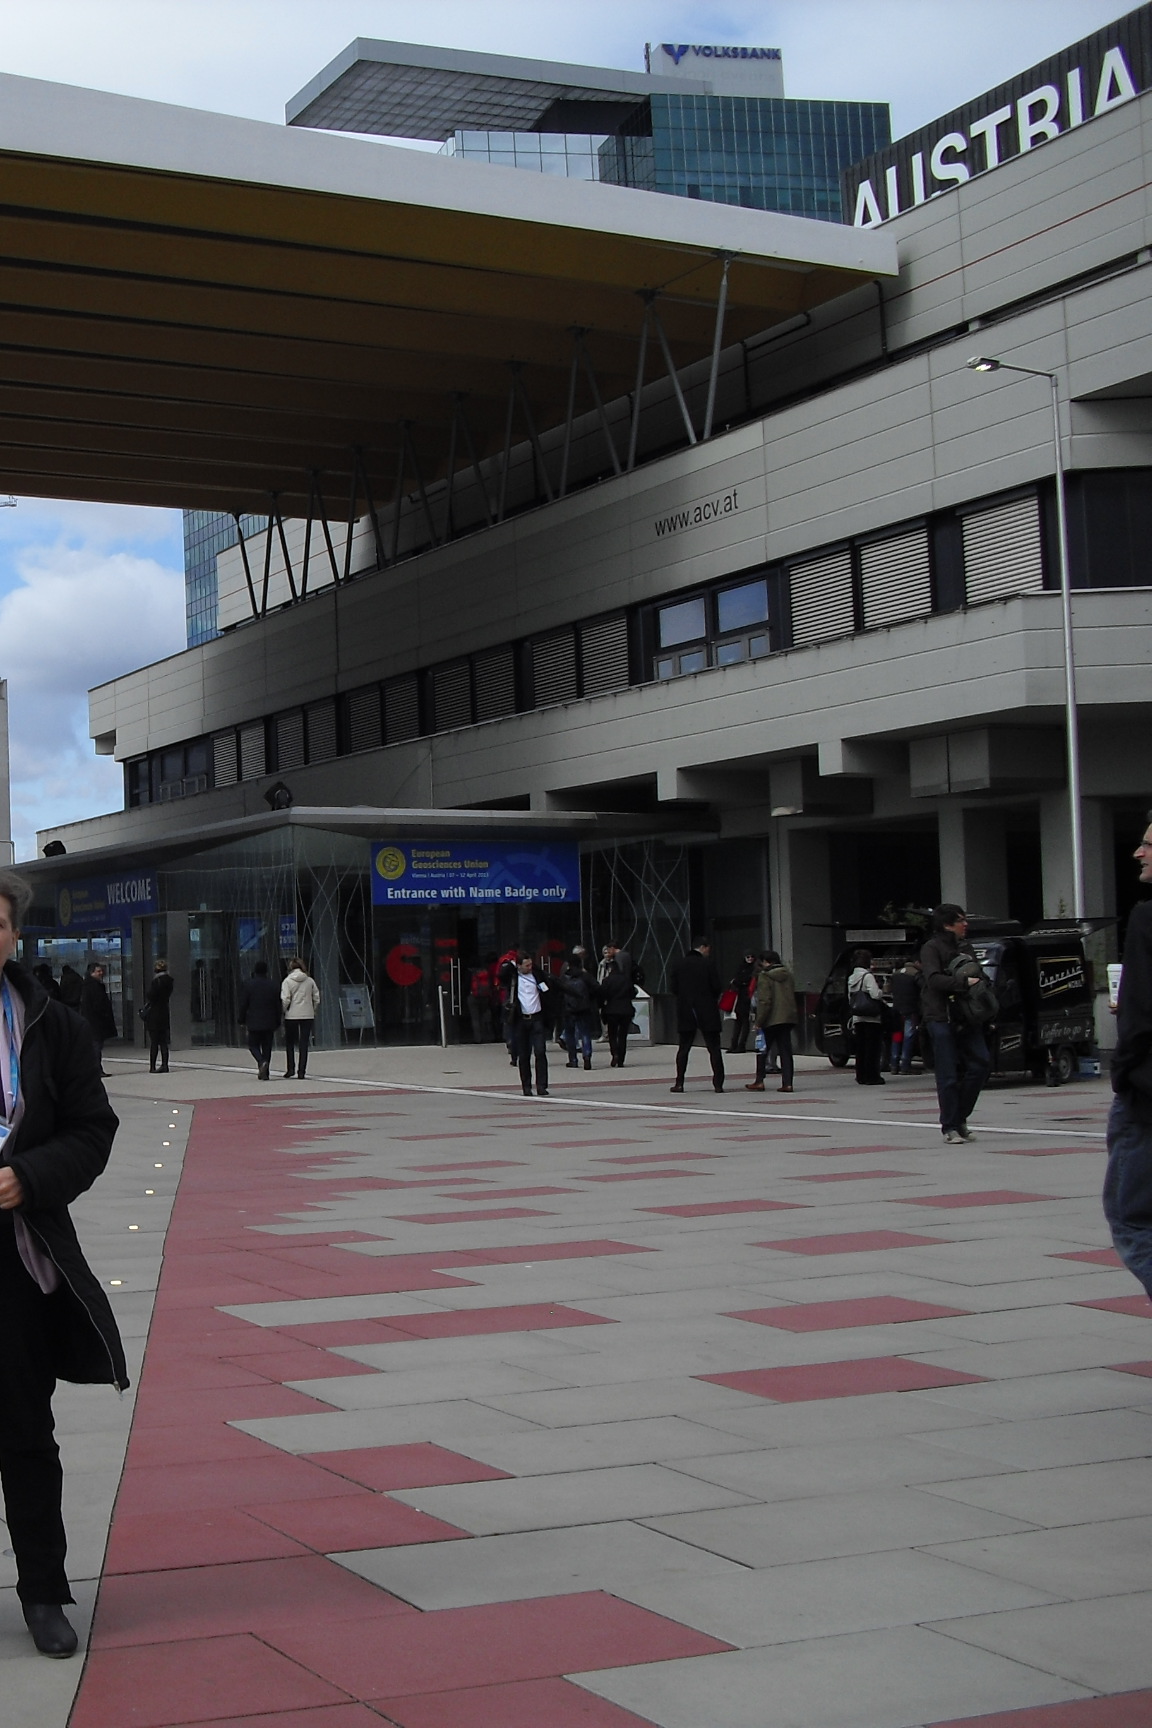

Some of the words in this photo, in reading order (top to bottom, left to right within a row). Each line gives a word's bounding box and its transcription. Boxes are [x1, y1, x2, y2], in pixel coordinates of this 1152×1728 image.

[692, 44, 782, 60] VOLKSBANK
[853, 45, 1137, 229] AUSTRIA
[654, 488, 739, 537] www.acv.at
[411, 849, 451, 859] European
[411, 860, 462, 869] Geosciences
[464, 859, 489, 868] Union
[107, 878, 152, 905] WELCOME
[387, 887, 438, 899] Entrance
[440, 886, 466, 898] with
[469, 886, 501, 898] Name
[504, 885, 539, 899] Badge
[542, 885, 567, 899] only
[1039, 965, 1084, 988] Espresso
[1068, 1026, 1082, 1040] go
